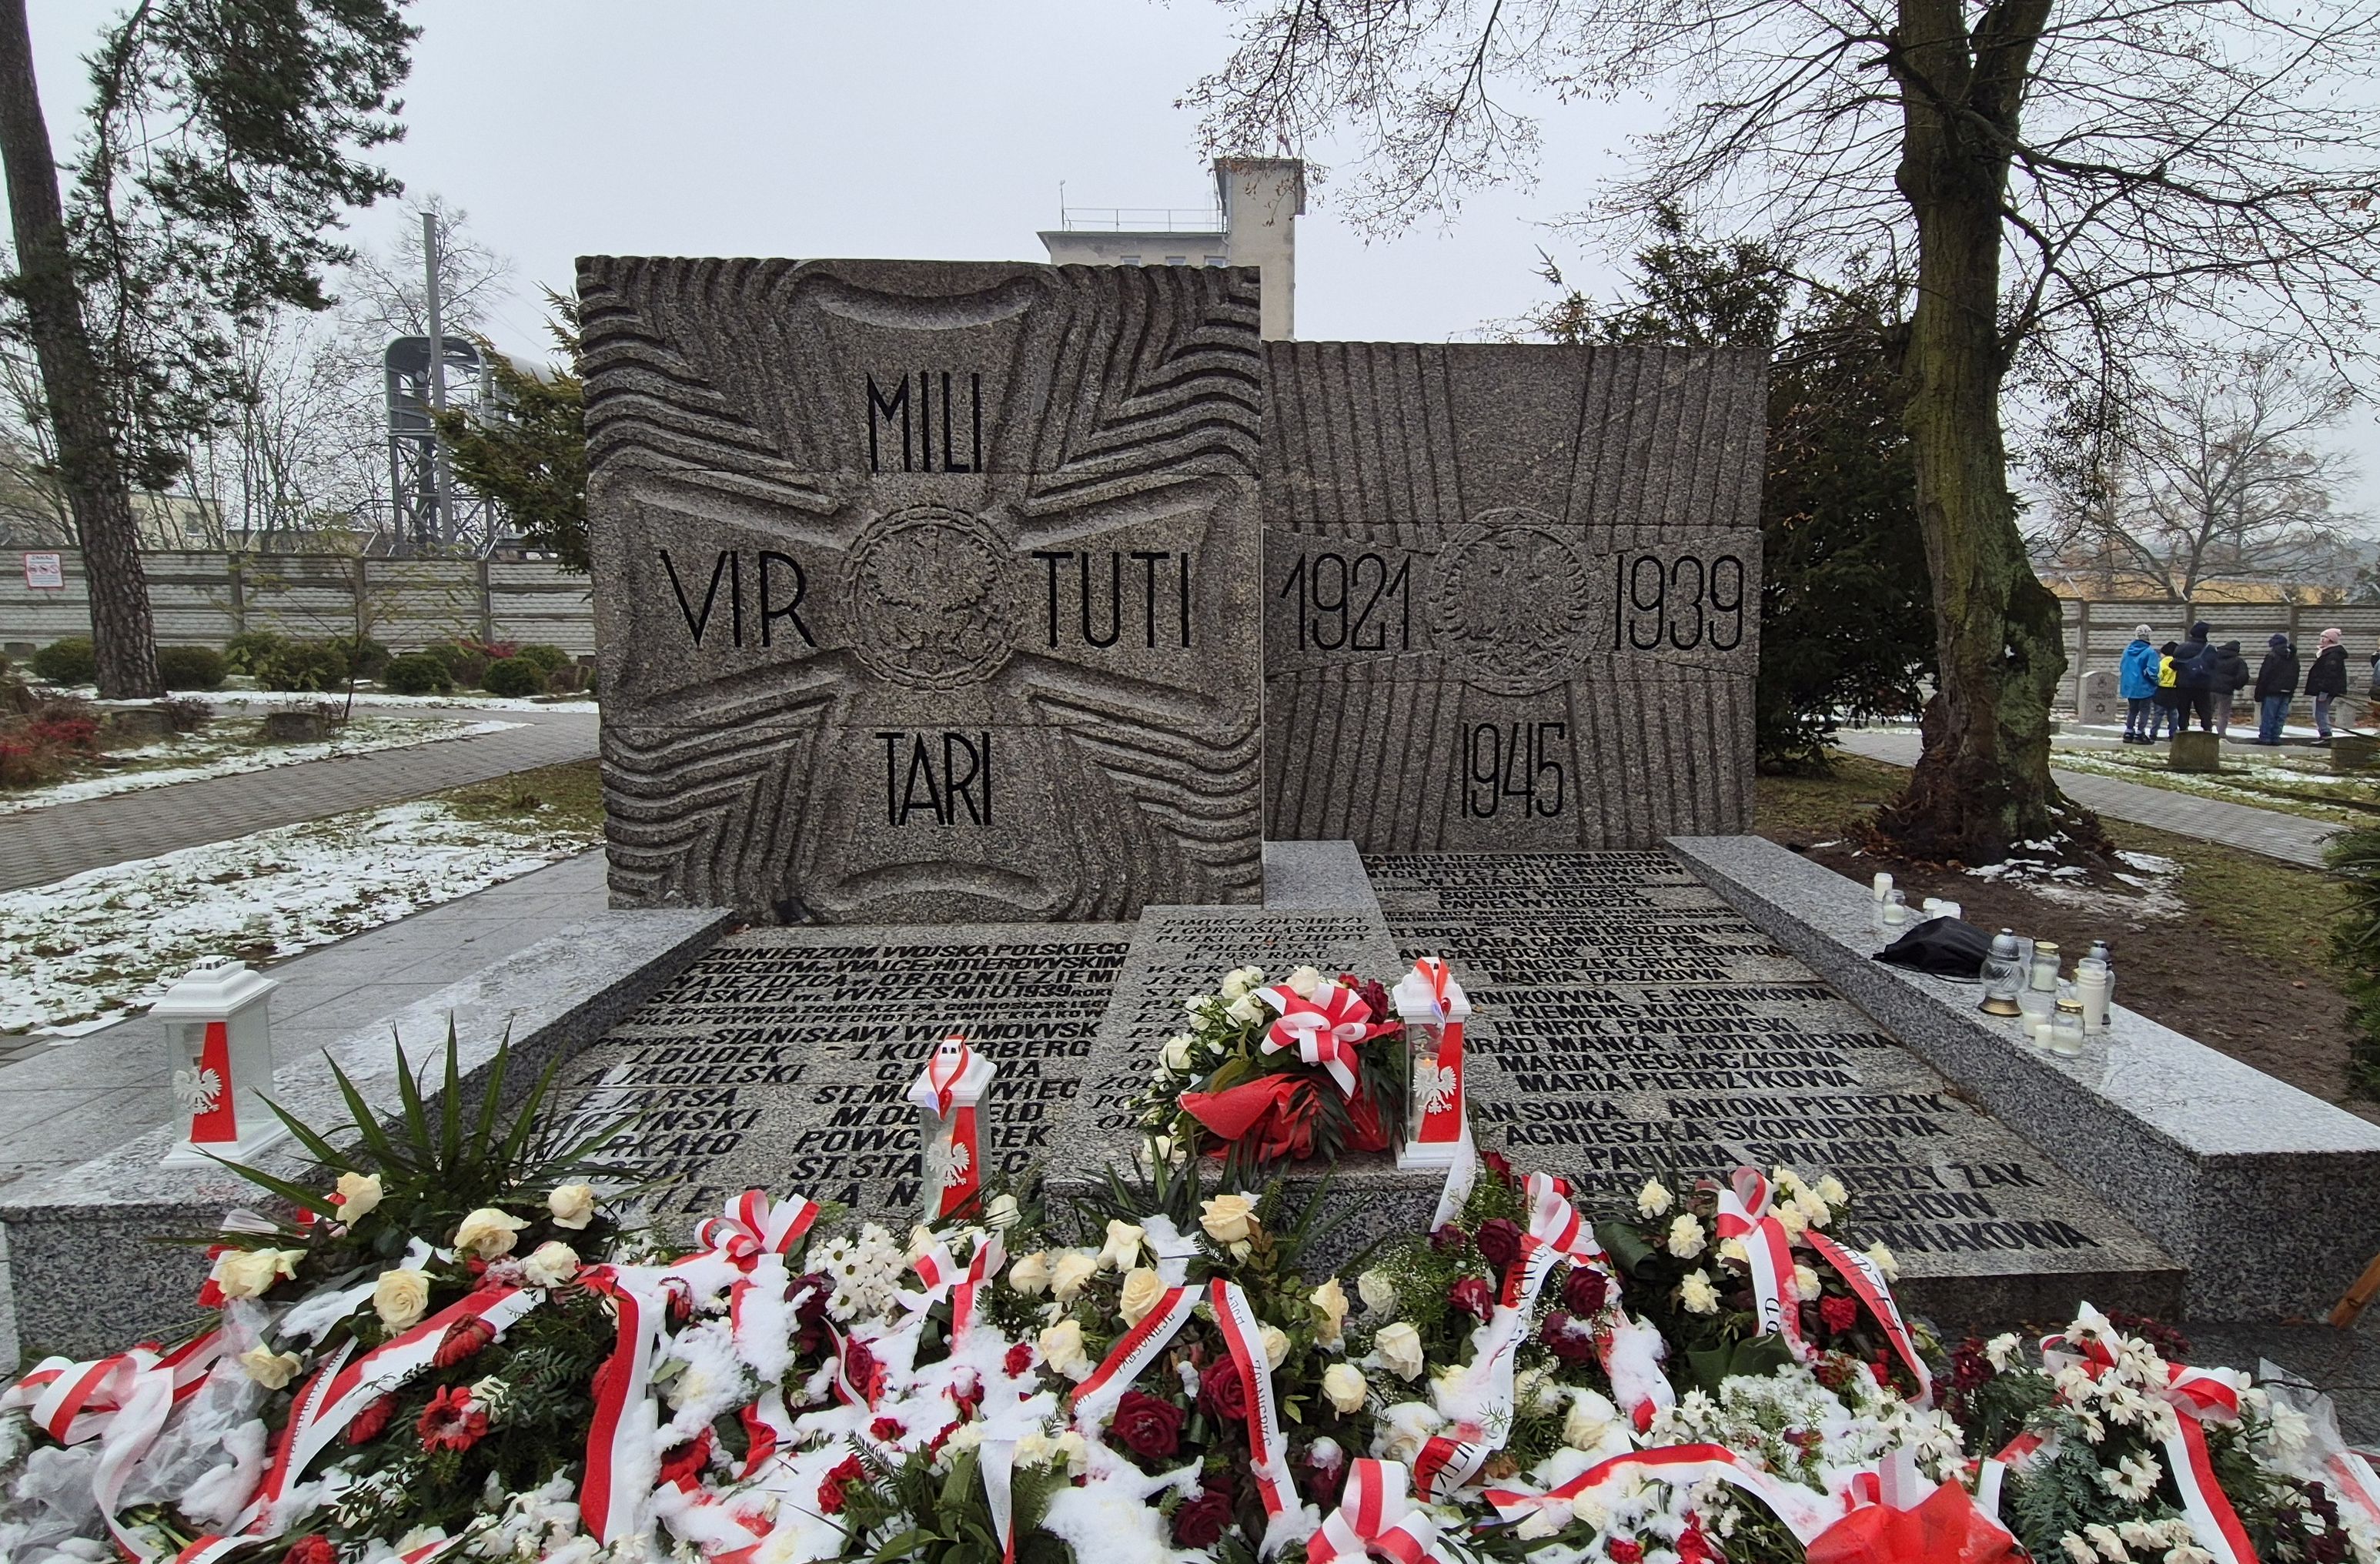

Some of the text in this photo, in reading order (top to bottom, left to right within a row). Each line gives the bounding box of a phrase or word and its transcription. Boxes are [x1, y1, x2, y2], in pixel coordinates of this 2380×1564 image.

[867, 373, 982, 474] MILI
[659, 549, 1191, 649] VIR TUTI
[1280, 552, 1743, 651] 1921 1939
[875, 731, 992, 827] TARI
[1462, 722, 1565, 819] 1945
[1451, 877, 1539, 886] LATACH
[1439, 890, 1644, 900] BOGDAN WRZOSEK
[1509, 926, 1600, 937] STEFAN
[883, 945, 988, 958] WOJSKA
[992, 943, 1131, 956] POLSKIEGO
[1450, 937, 1528, 948] KLARA
[1399, 948, 1432, 961] AN
[1466, 958, 1626, 971] FRANCISZEK
[879, 971, 1030, 987] OBRONIE
[1033, 970, 1123, 984] ZIEMI
[1585, 969, 1733, 982] PACZKOWA
[1014, 984, 1073, 998] 1939
[1509, 1004, 1641, 1018] KLEMENS
[706, 1025, 900, 1044] STANISŁAW
[1493, 1020, 1610, 1036] HENRYK
[1676, 1034, 1767, 1051] PIOTR
[1495, 1051, 1854, 1072] MARIA PIECHACZKOWA
[1516, 1070, 1864, 1092] MARIA PIETRZYKOWA
[1478, 1101, 1518, 1122] AN
[1667, 1097, 1793, 1119] ANTONI
[1787, 1093, 1957, 1116] PIETRZYK
[1506, 1116, 1954, 1146] AGNIESZKA SKORUPOWA
